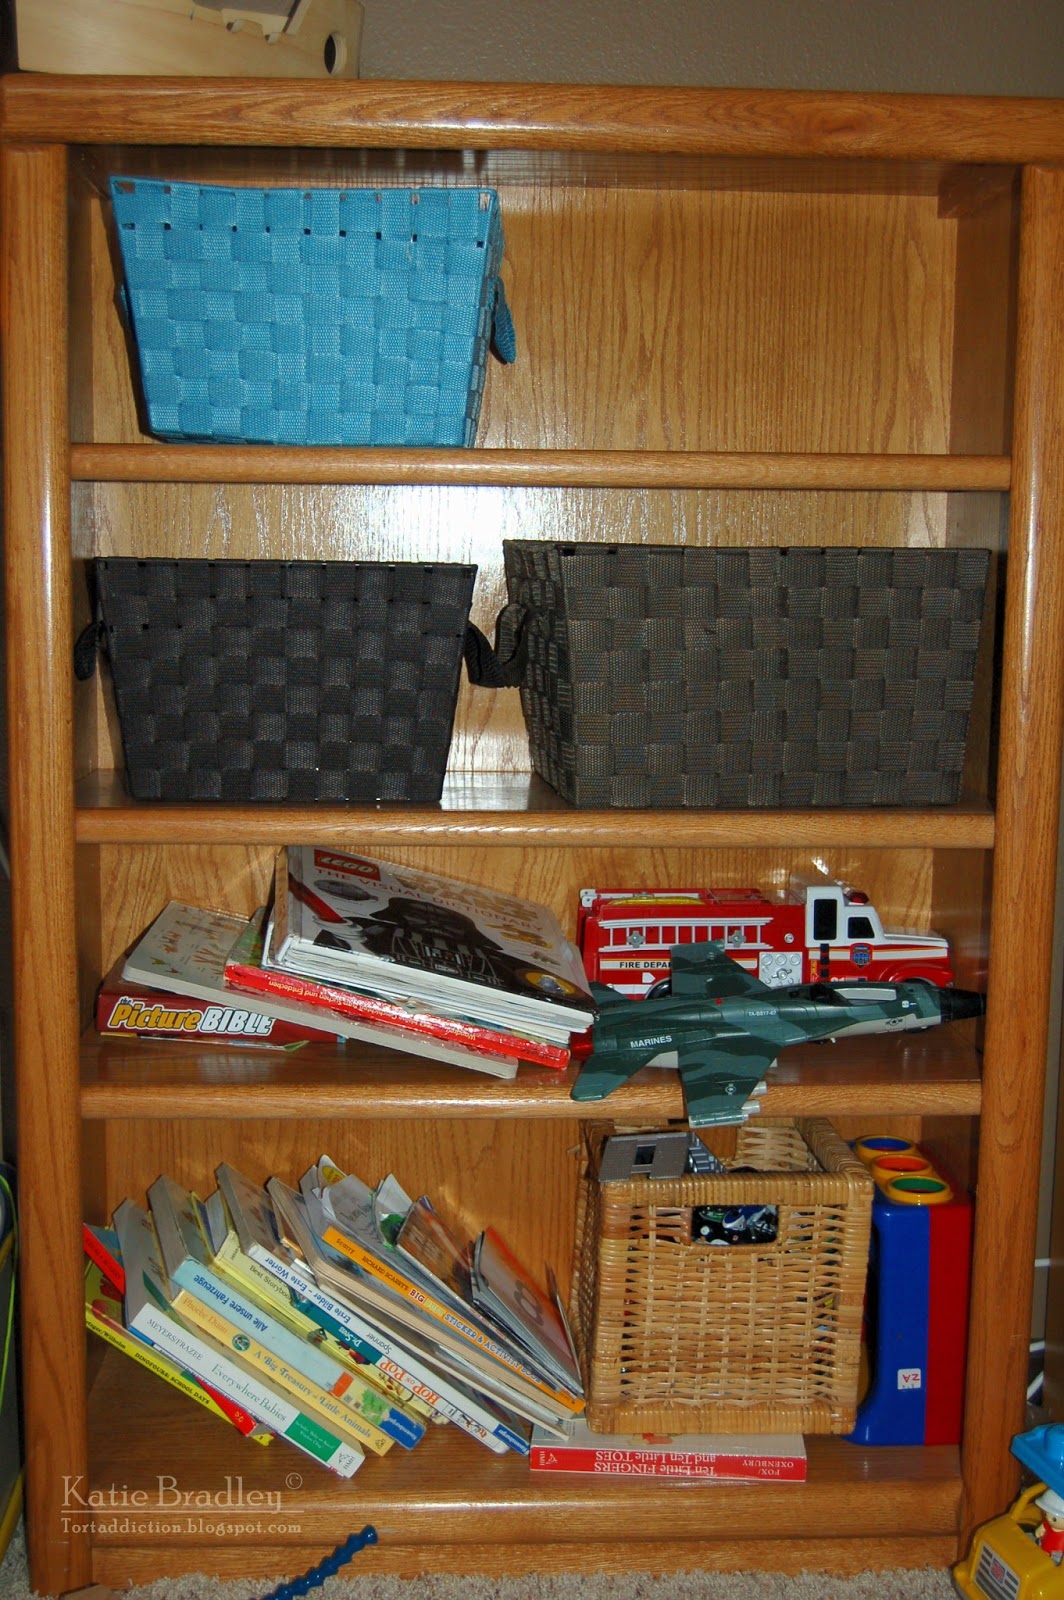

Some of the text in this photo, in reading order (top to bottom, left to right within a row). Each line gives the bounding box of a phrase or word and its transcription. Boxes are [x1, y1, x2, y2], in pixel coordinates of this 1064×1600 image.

[320, 857, 376, 873] LEGO
[314, 866, 543, 932] THE VISUAL DICTIONARY
[619, 961, 641, 969] FIRE
[268, 979, 304, 994] Entdecken
[305, 989, 318, 998] und
[318, 993, 342, 1005] Suchen
[109, 1003, 276, 1035] Picture BIBLE
[630, 1035, 673, 1048] MARINES
[249, 1265, 264, 1277] Best
[262, 1255, 290, 1279] Wörter
[288, 1274, 308, 1291] Erste
[191, 1272, 268, 1333] Alle unsere Fahrzeuge
[311, 1291, 334, 1311] Bilder
[181, 1297, 229, 1334] Phoebe Dunn
[332, 1307, 351, 1324] Erste
[360, 1255, 386, 1275] RICHARD
[408, 1288, 425, 1303] BIG
[443, 1312, 477, 1339] STICKER
[476, 1335, 484, 1343] &
[483, 1339, 521, 1369] ACTIVITY
[364, 1331, 392, 1355] Spanner
[145, 1317, 204, 1361] MEYERS/FRAZEE
[209, 1361, 264, 1404] Everywhere
[258, 1396, 290, 1422] Babies
[378, 1356, 407, 1382] POP
[170, 1375, 194, 1394] SCHOOL
[192, 1390, 210, 1405] DAYS
[252, 1348, 263, 1359] A
[260, 1354, 280, 1372] Big
[276, 1365, 314, 1396] Treasury
[316, 1394, 342, 1416] Little
[339, 1411, 372, 1438] Animals
[412, 1381, 440, 1406] HOP
[594, 1450, 715, 1465] and Ten Little TOES
[742, 1459, 793, 1468] OXENBURY
[593, 1460, 716, 1476] Ten Little FINGERS
